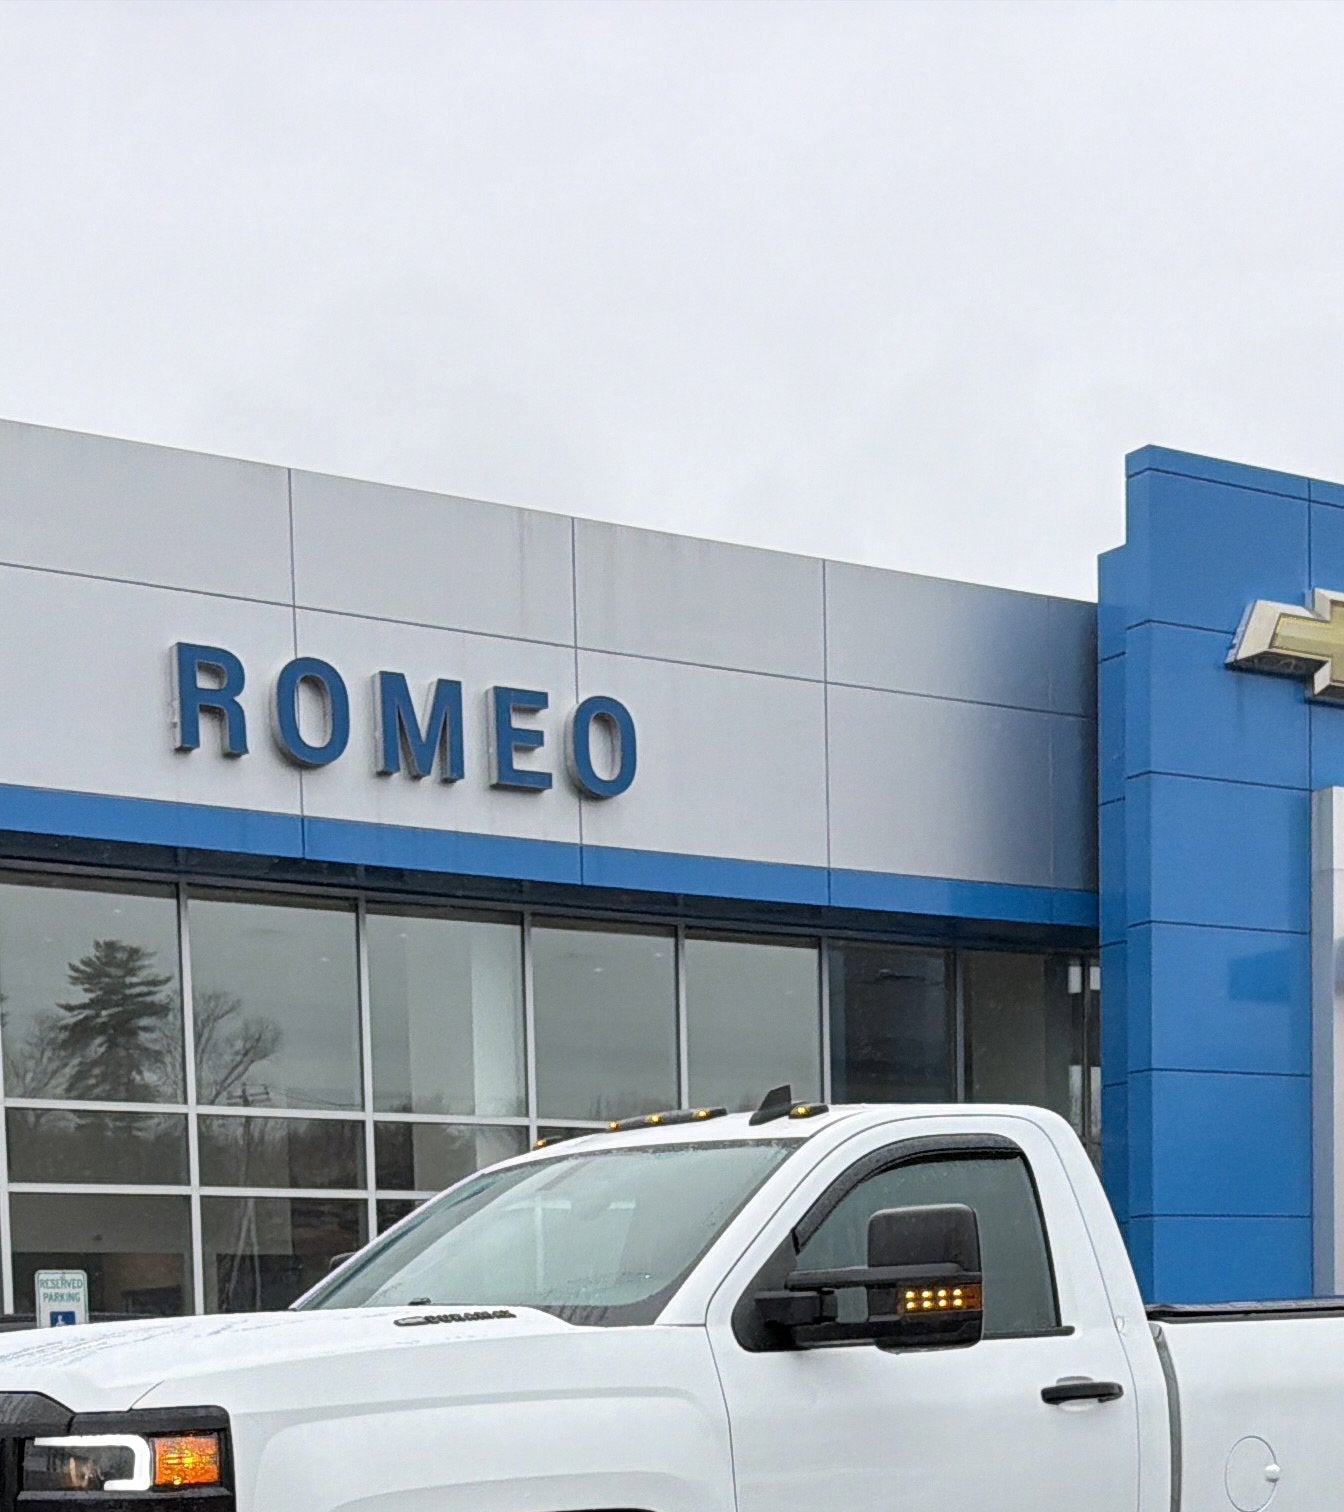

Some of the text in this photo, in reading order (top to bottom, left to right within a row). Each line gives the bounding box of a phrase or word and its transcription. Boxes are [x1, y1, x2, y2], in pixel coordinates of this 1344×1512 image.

[170, 640, 638, 800] ROMEO
[39, 1279, 83, 1289] RESERVED
[43, 1292, 80, 1302] PARKING
